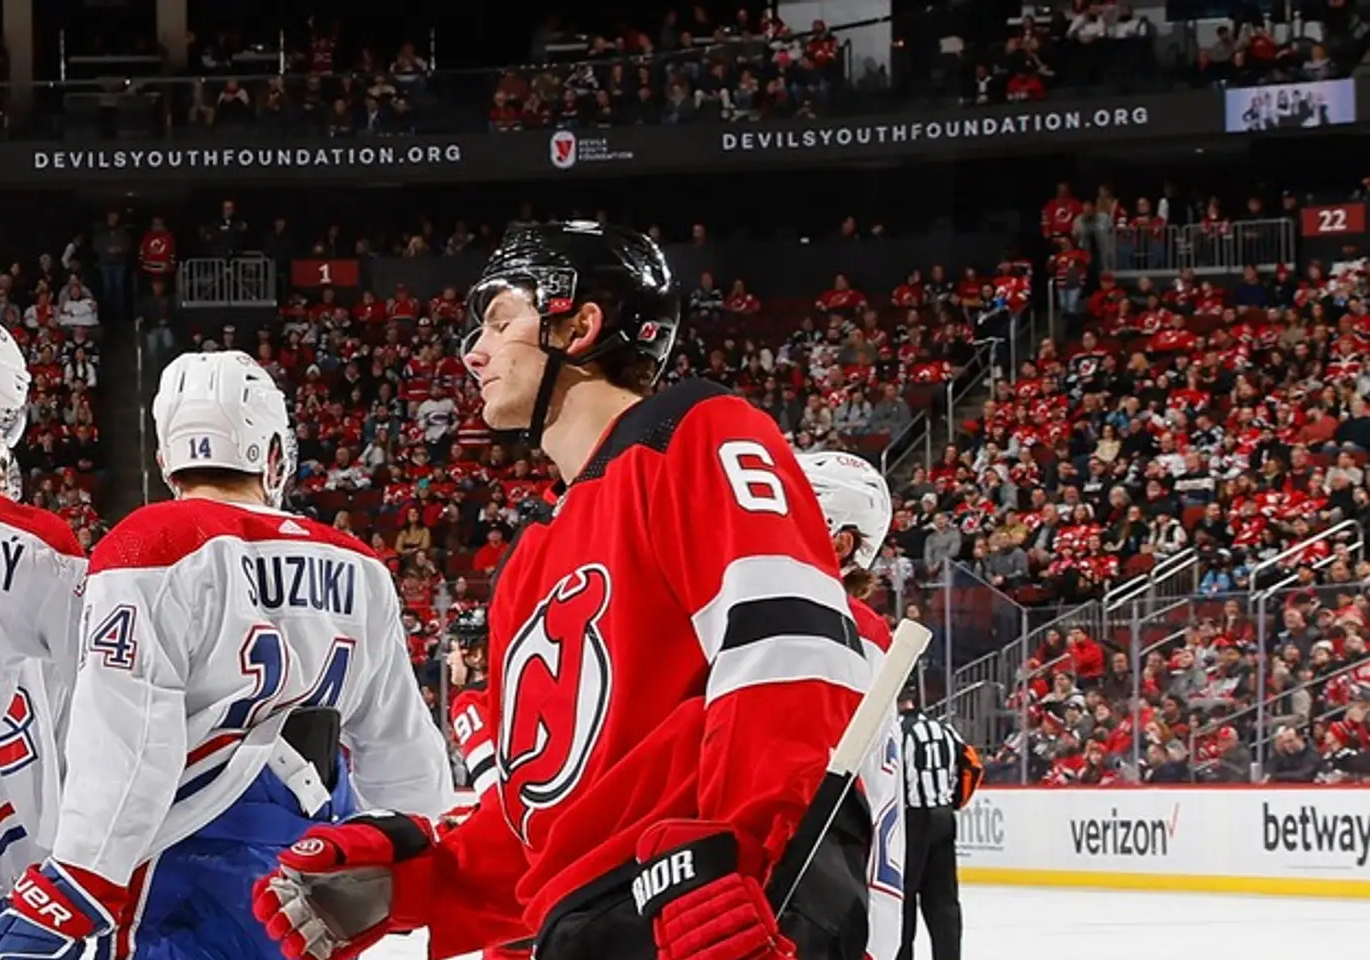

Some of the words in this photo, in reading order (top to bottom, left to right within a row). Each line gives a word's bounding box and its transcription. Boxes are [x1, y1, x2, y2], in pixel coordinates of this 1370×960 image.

[721, 105, 1150, 151] DEVILSYOUTHFOUNDATION.ORG
[33, 144, 462, 170] DEVILSYOUTHFOUNDATION.ORG
[1317, 208, 1348, 232] 22
[318, 263, 332, 285] 1
[188, 436, 213, 460] 14
[717, 438, 790, 517] 6
[240, 554, 356, 616] SUZUKI
[1070, 807, 1168, 856] verizon
[1262, 801, 1370, 867] betway
